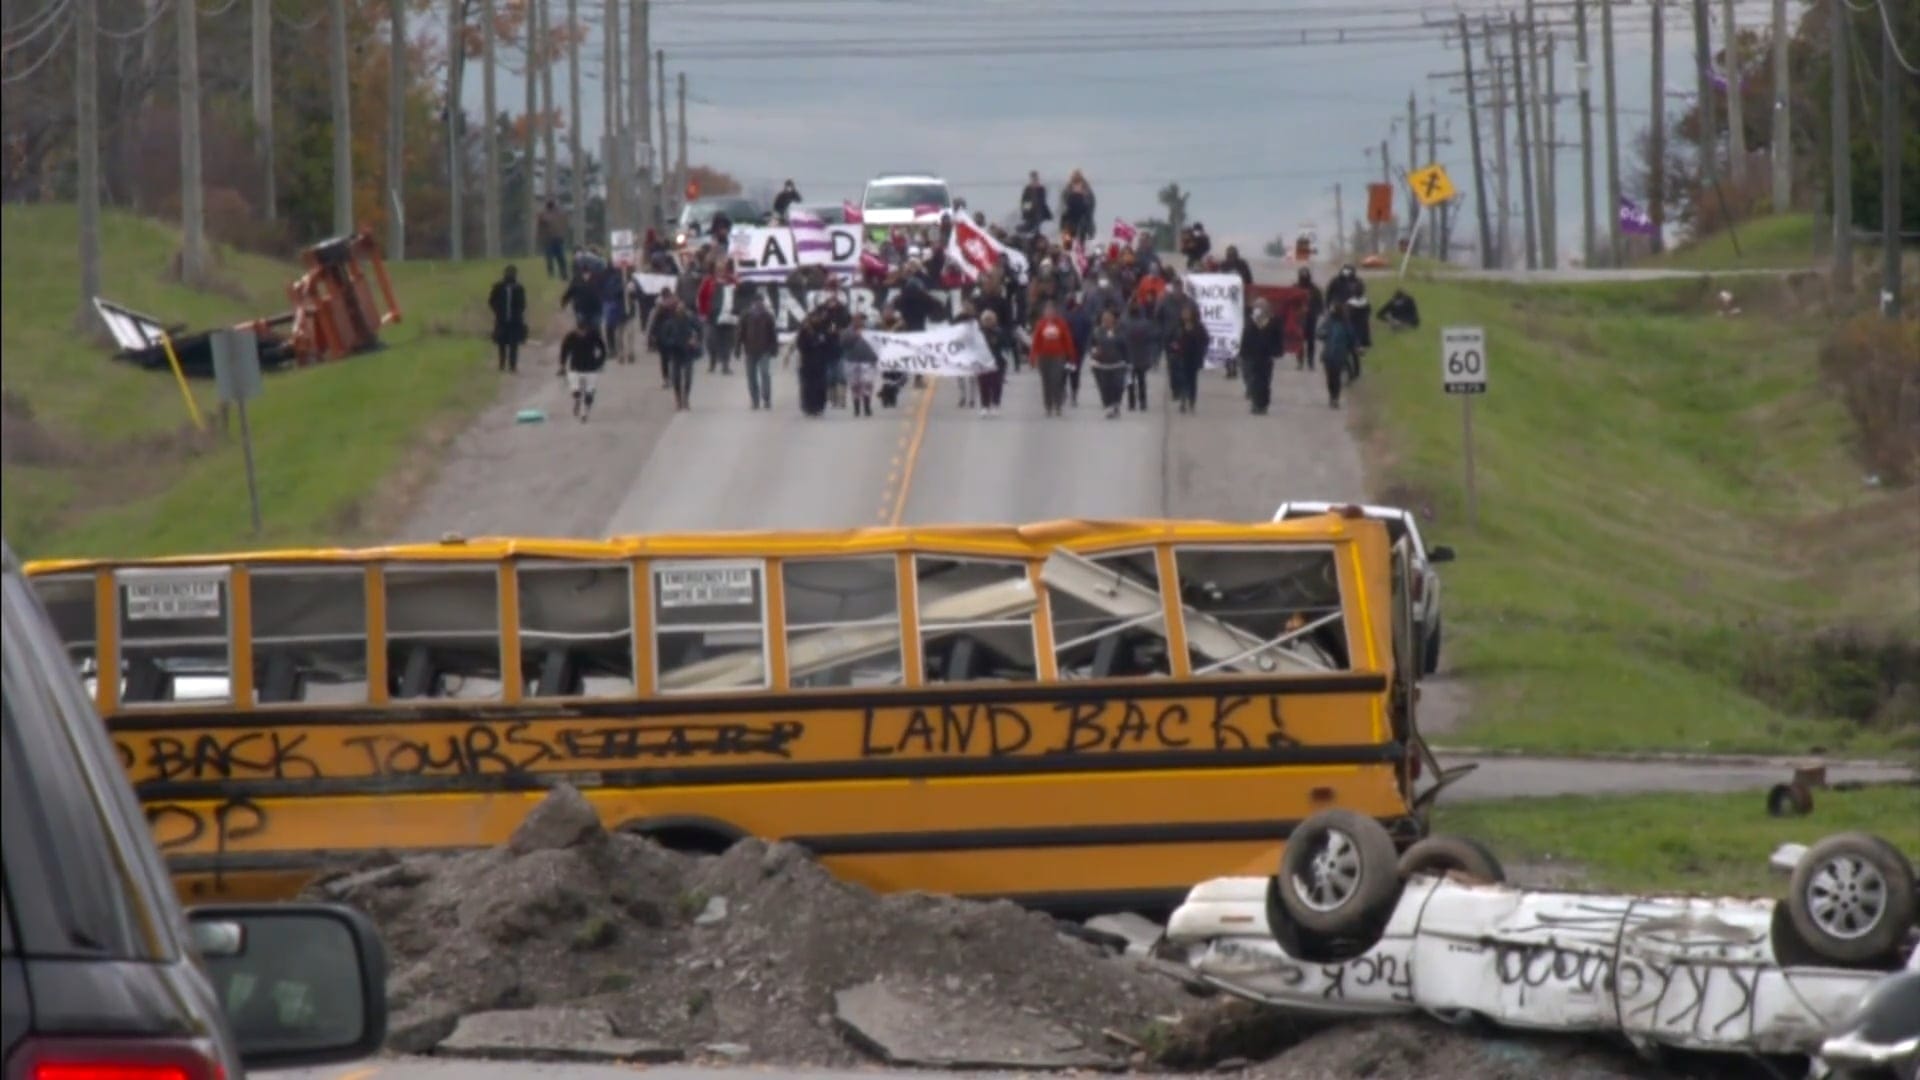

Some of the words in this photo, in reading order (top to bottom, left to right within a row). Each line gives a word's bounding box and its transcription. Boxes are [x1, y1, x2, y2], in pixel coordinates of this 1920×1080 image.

[1448, 350, 1481, 376] 60
[861, 703, 1033, 758] LAND
[1045, 696, 1299, 756] BACK!
[147, 732, 319, 779] BACK
